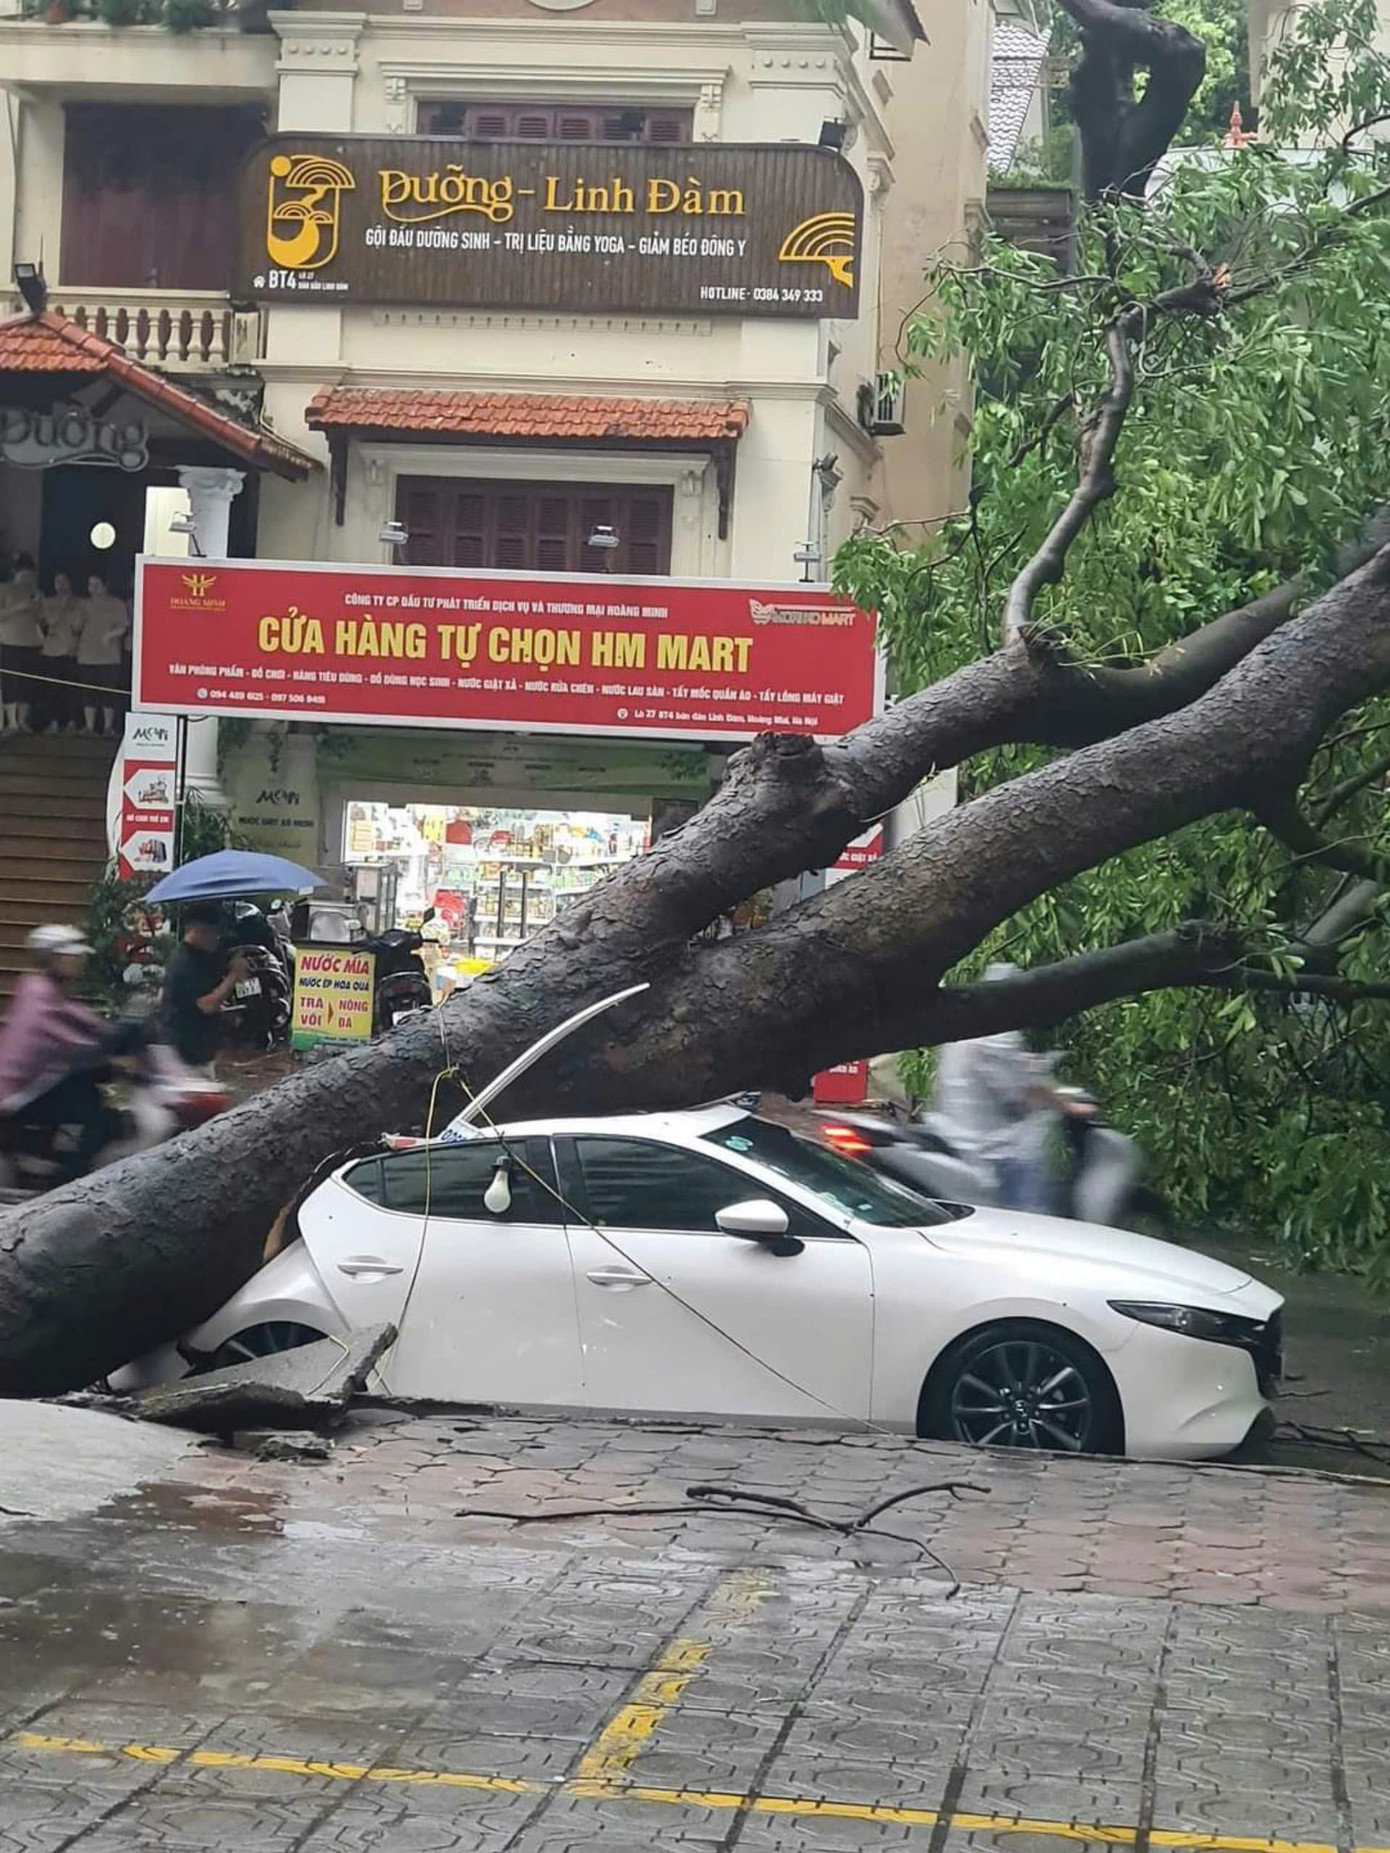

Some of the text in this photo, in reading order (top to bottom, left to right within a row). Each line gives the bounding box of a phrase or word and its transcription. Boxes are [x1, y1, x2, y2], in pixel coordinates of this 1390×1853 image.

[543, 176, 635, 213] Linh
[646, 176, 746, 215] Đàm
[366, 226, 386, 248] GỘI
[461, 232, 490, 250] SINH
[505, 232, 525, 254] TRỊ
[528, 228, 554, 254] LIỆU
[594, 236, 625, 254] YOGA
[639, 230, 670, 255] GIẢM
[673, 232, 698, 256] BÉO
[738, 239, 747, 257] Y
[268, 269, 297, 290] BT4
[753, 287, 780, 301] 0384
[782, 289, 801, 301] 349
[803, 289, 823, 302] 333
[345, 592, 371, 606] CÔNG
[373, 594, 385, 606] TY
[386, 596, 400, 607] CP
[423, 596, 435, 609] TƯ
[492, 600, 516, 613] DỊCH
[517, 601, 530, 615] VỤ
[532, 600, 545, 613] VÀ
[607, 604, 640, 617] HOÀNG
[258, 606, 754, 673] CỬA HÀNG TỰ CHỌN HM MART
[300, 953, 370, 975] NƯỚC MÍA
[299, 975, 322, 988] NƯỚC
